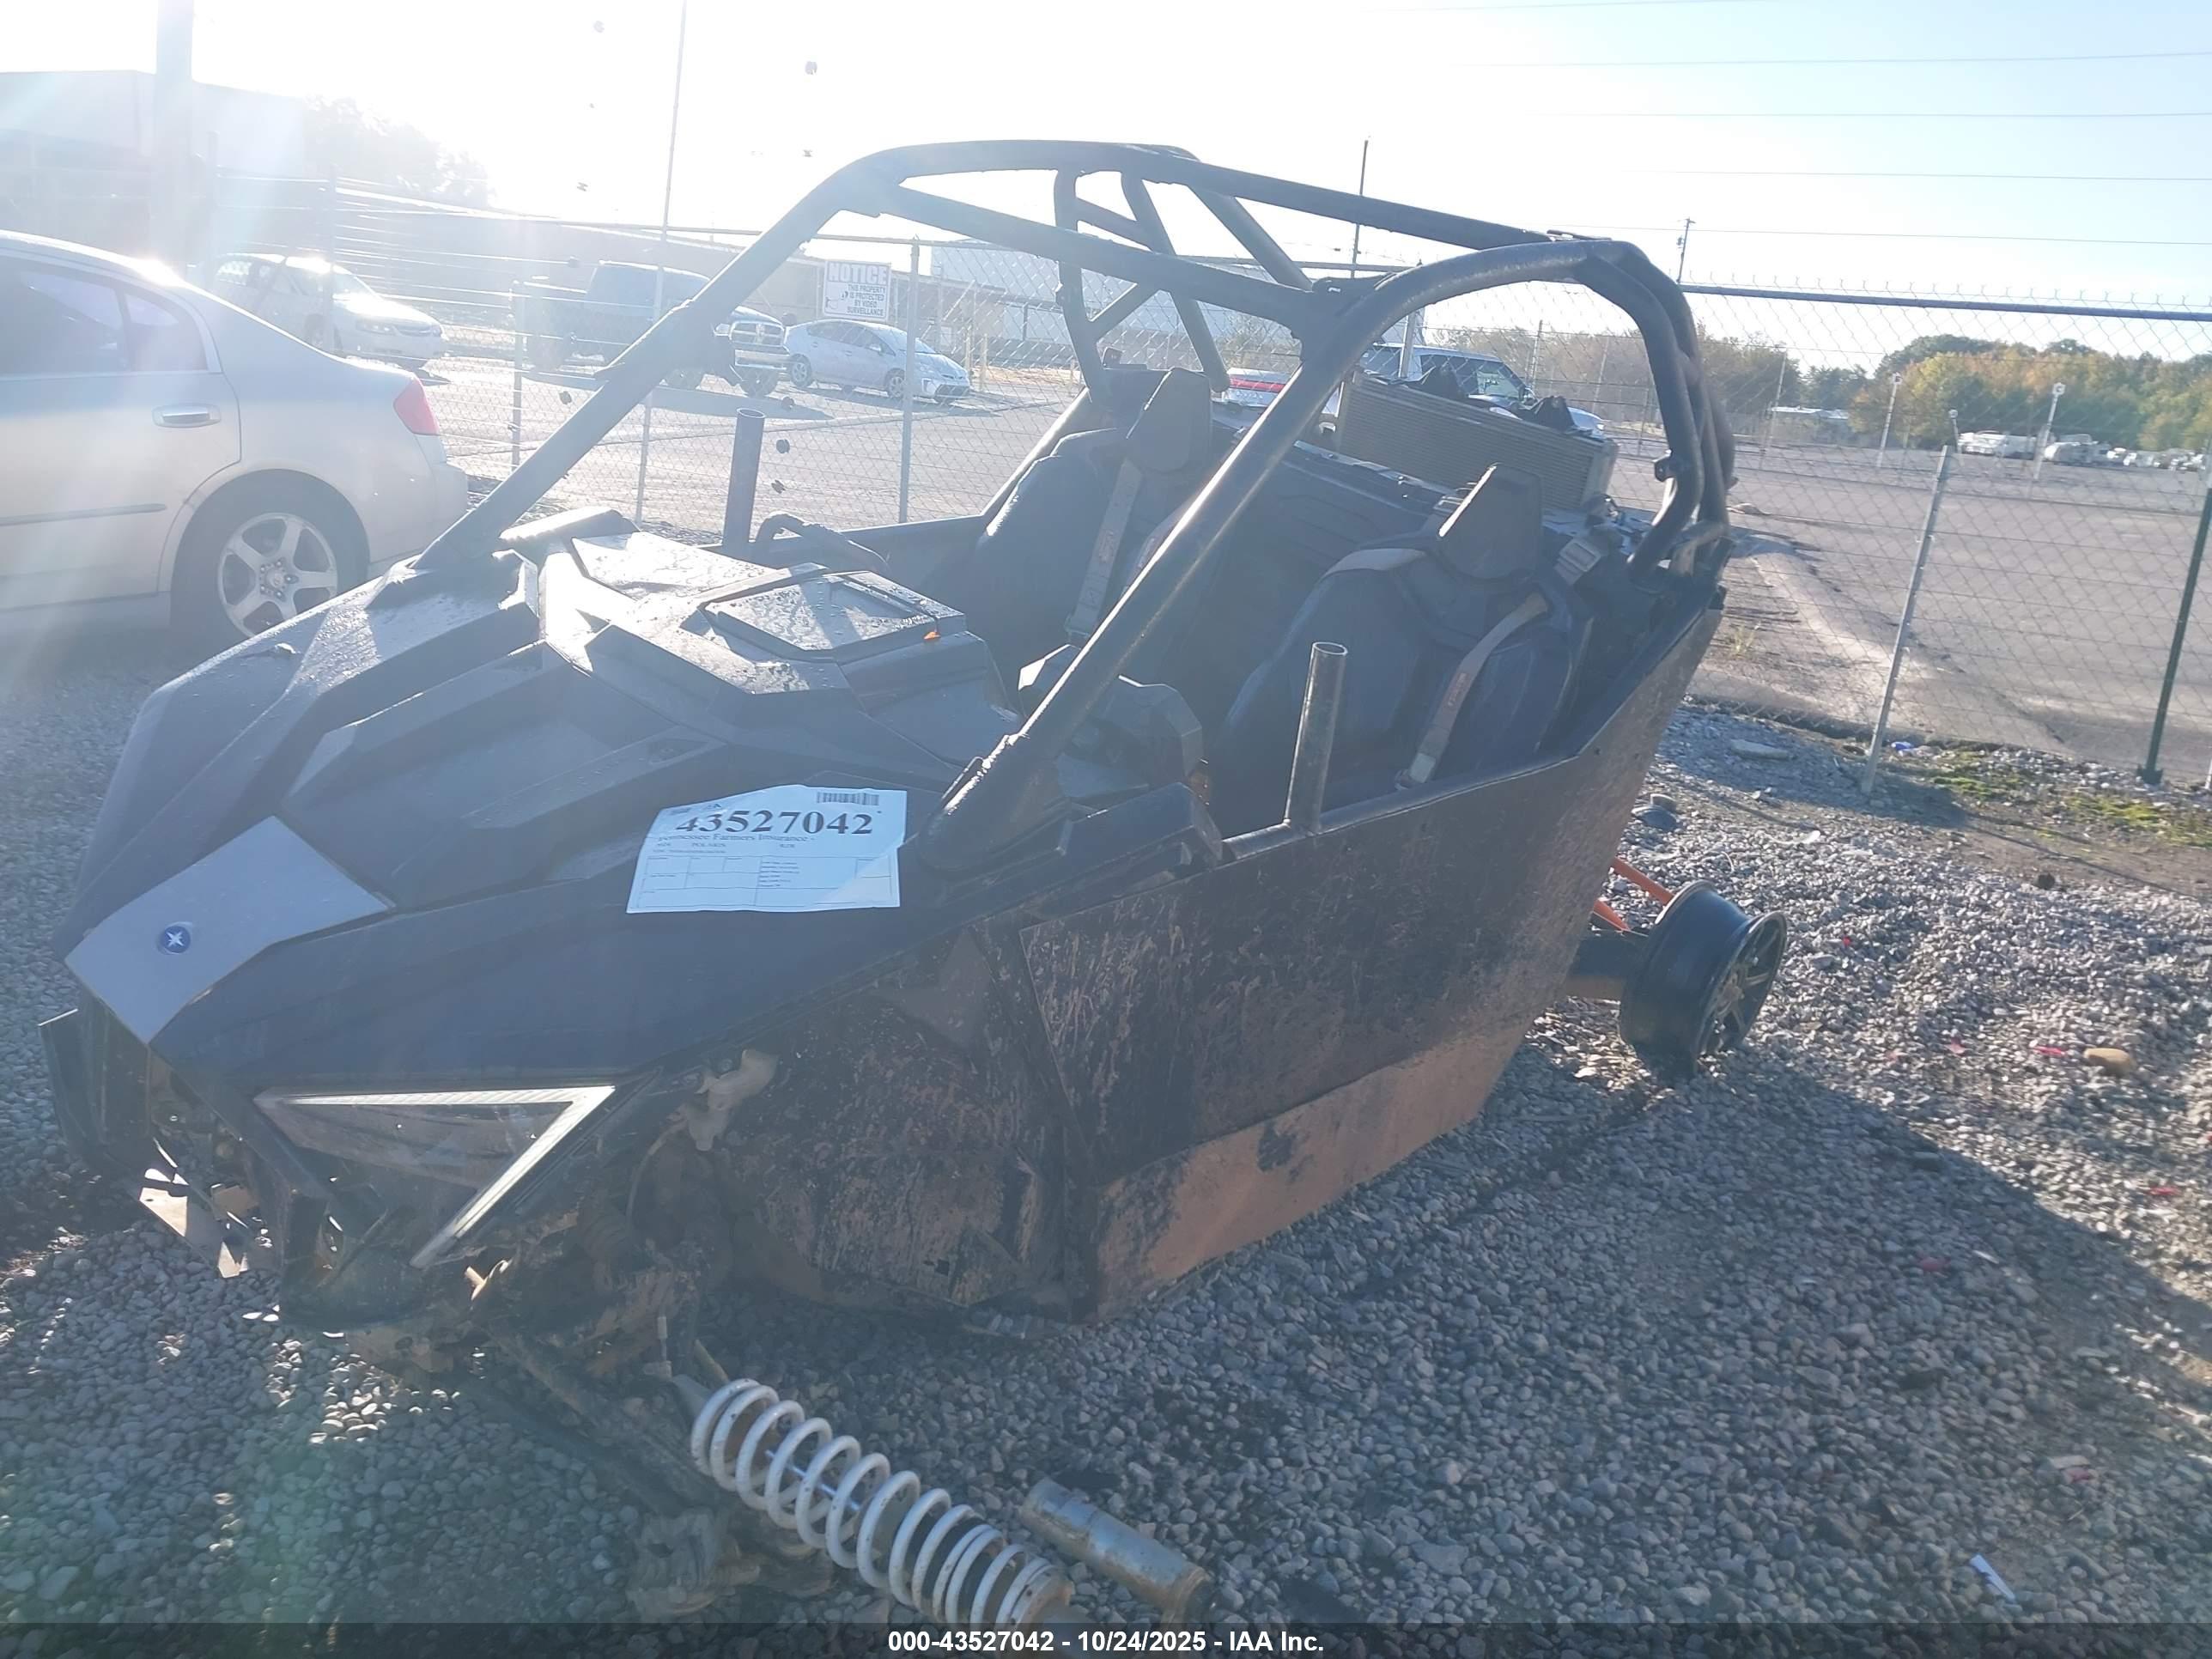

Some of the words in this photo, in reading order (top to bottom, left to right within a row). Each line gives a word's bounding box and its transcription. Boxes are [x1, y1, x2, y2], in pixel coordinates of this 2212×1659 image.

[828, 262, 888, 285] NOTICE
[860, 285, 885, 294] PROPERTY
[855, 293, 884, 301] PROTECTED
[847, 307, 884, 317] SURVEILLANCE
[676, 810, 873, 835] 43527042
